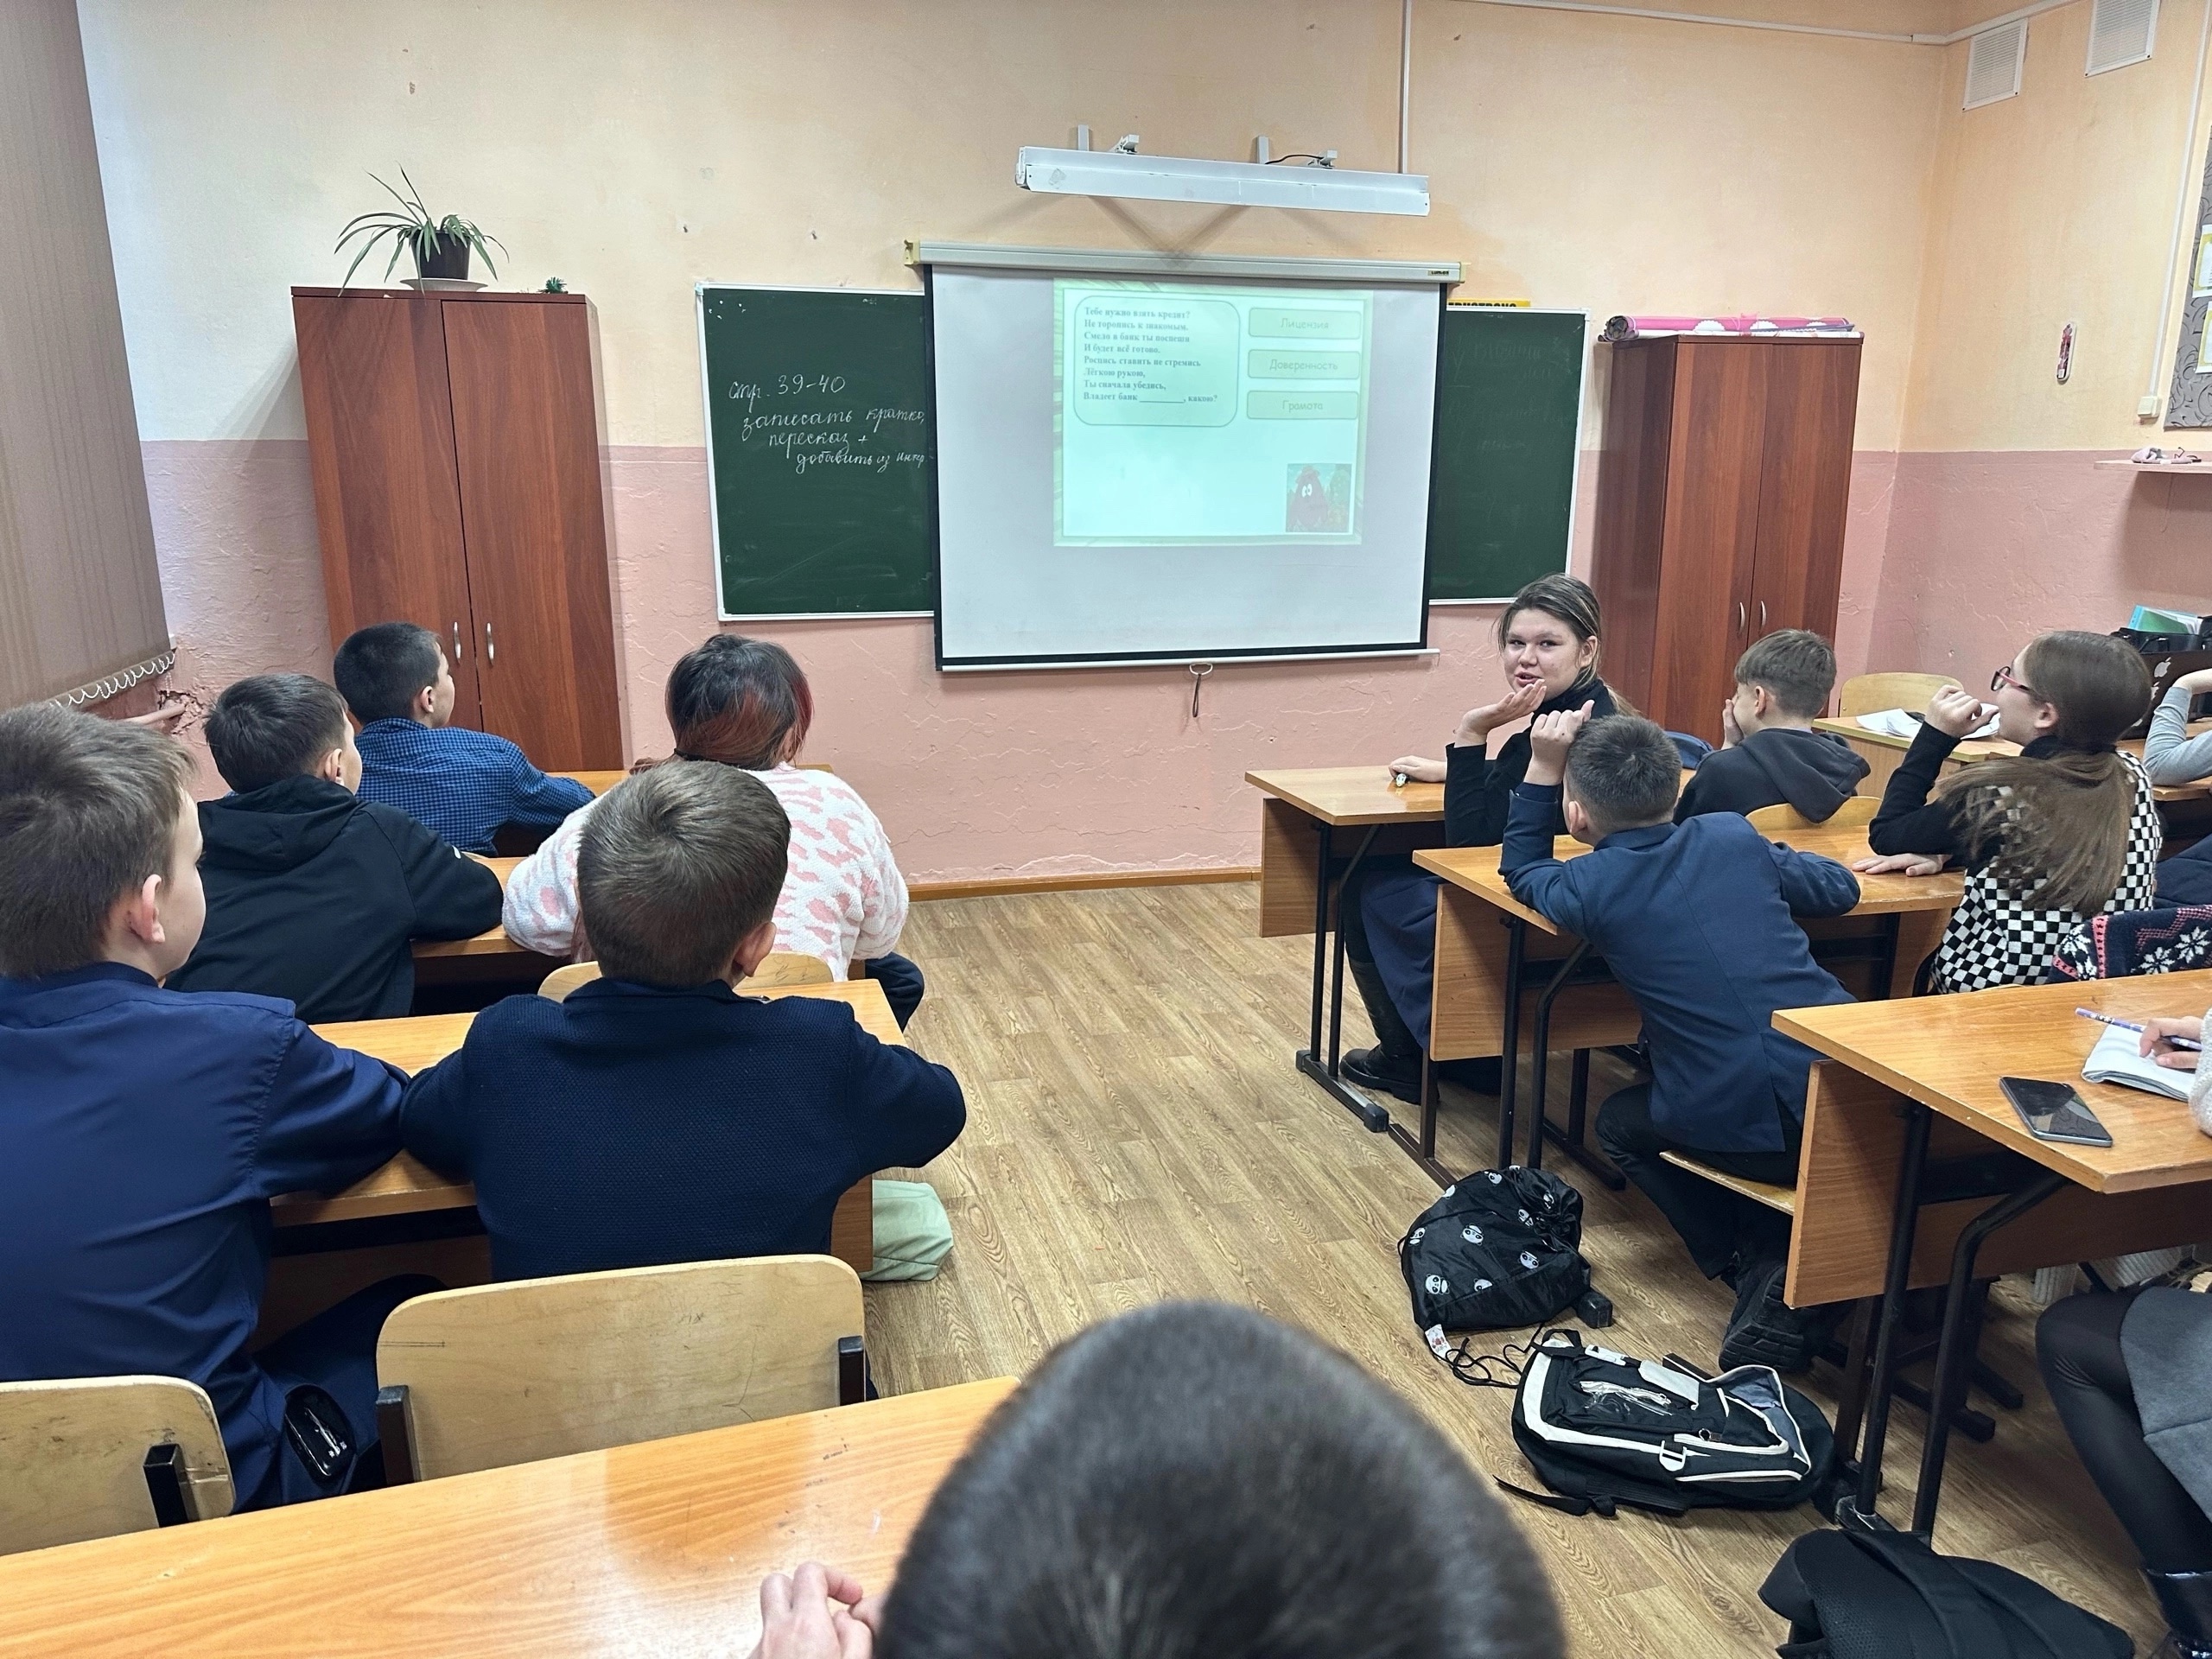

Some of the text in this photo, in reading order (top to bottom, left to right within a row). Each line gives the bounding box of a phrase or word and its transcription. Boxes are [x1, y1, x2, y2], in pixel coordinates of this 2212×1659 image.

[1084, 307, 1103, 316] Тебе
[1084, 319, 1096, 327] Не
[1097, 321, 1135, 330] торопись
[1281, 318, 1329, 330] Лицензия
[1084, 331, 1110, 340] Смело
[1084, 343, 1091, 352] И
[1093, 344, 1114, 353] будет
[1084, 355, 1116, 365] Роспись
[1269, 359, 1338, 372] Доверенность
[1084, 367, 1116, 377] Лёгкою
[778, 374, 846, 394] 39-40
[1118, 392, 1138, 401] банк
[1281, 400, 1324, 413] Грамота
[741, 410, 853, 442] записать
[768, 432, 850, 460] пересказ
[795, 448, 873, 474] добавить
[876, 454, 891, 474] из
